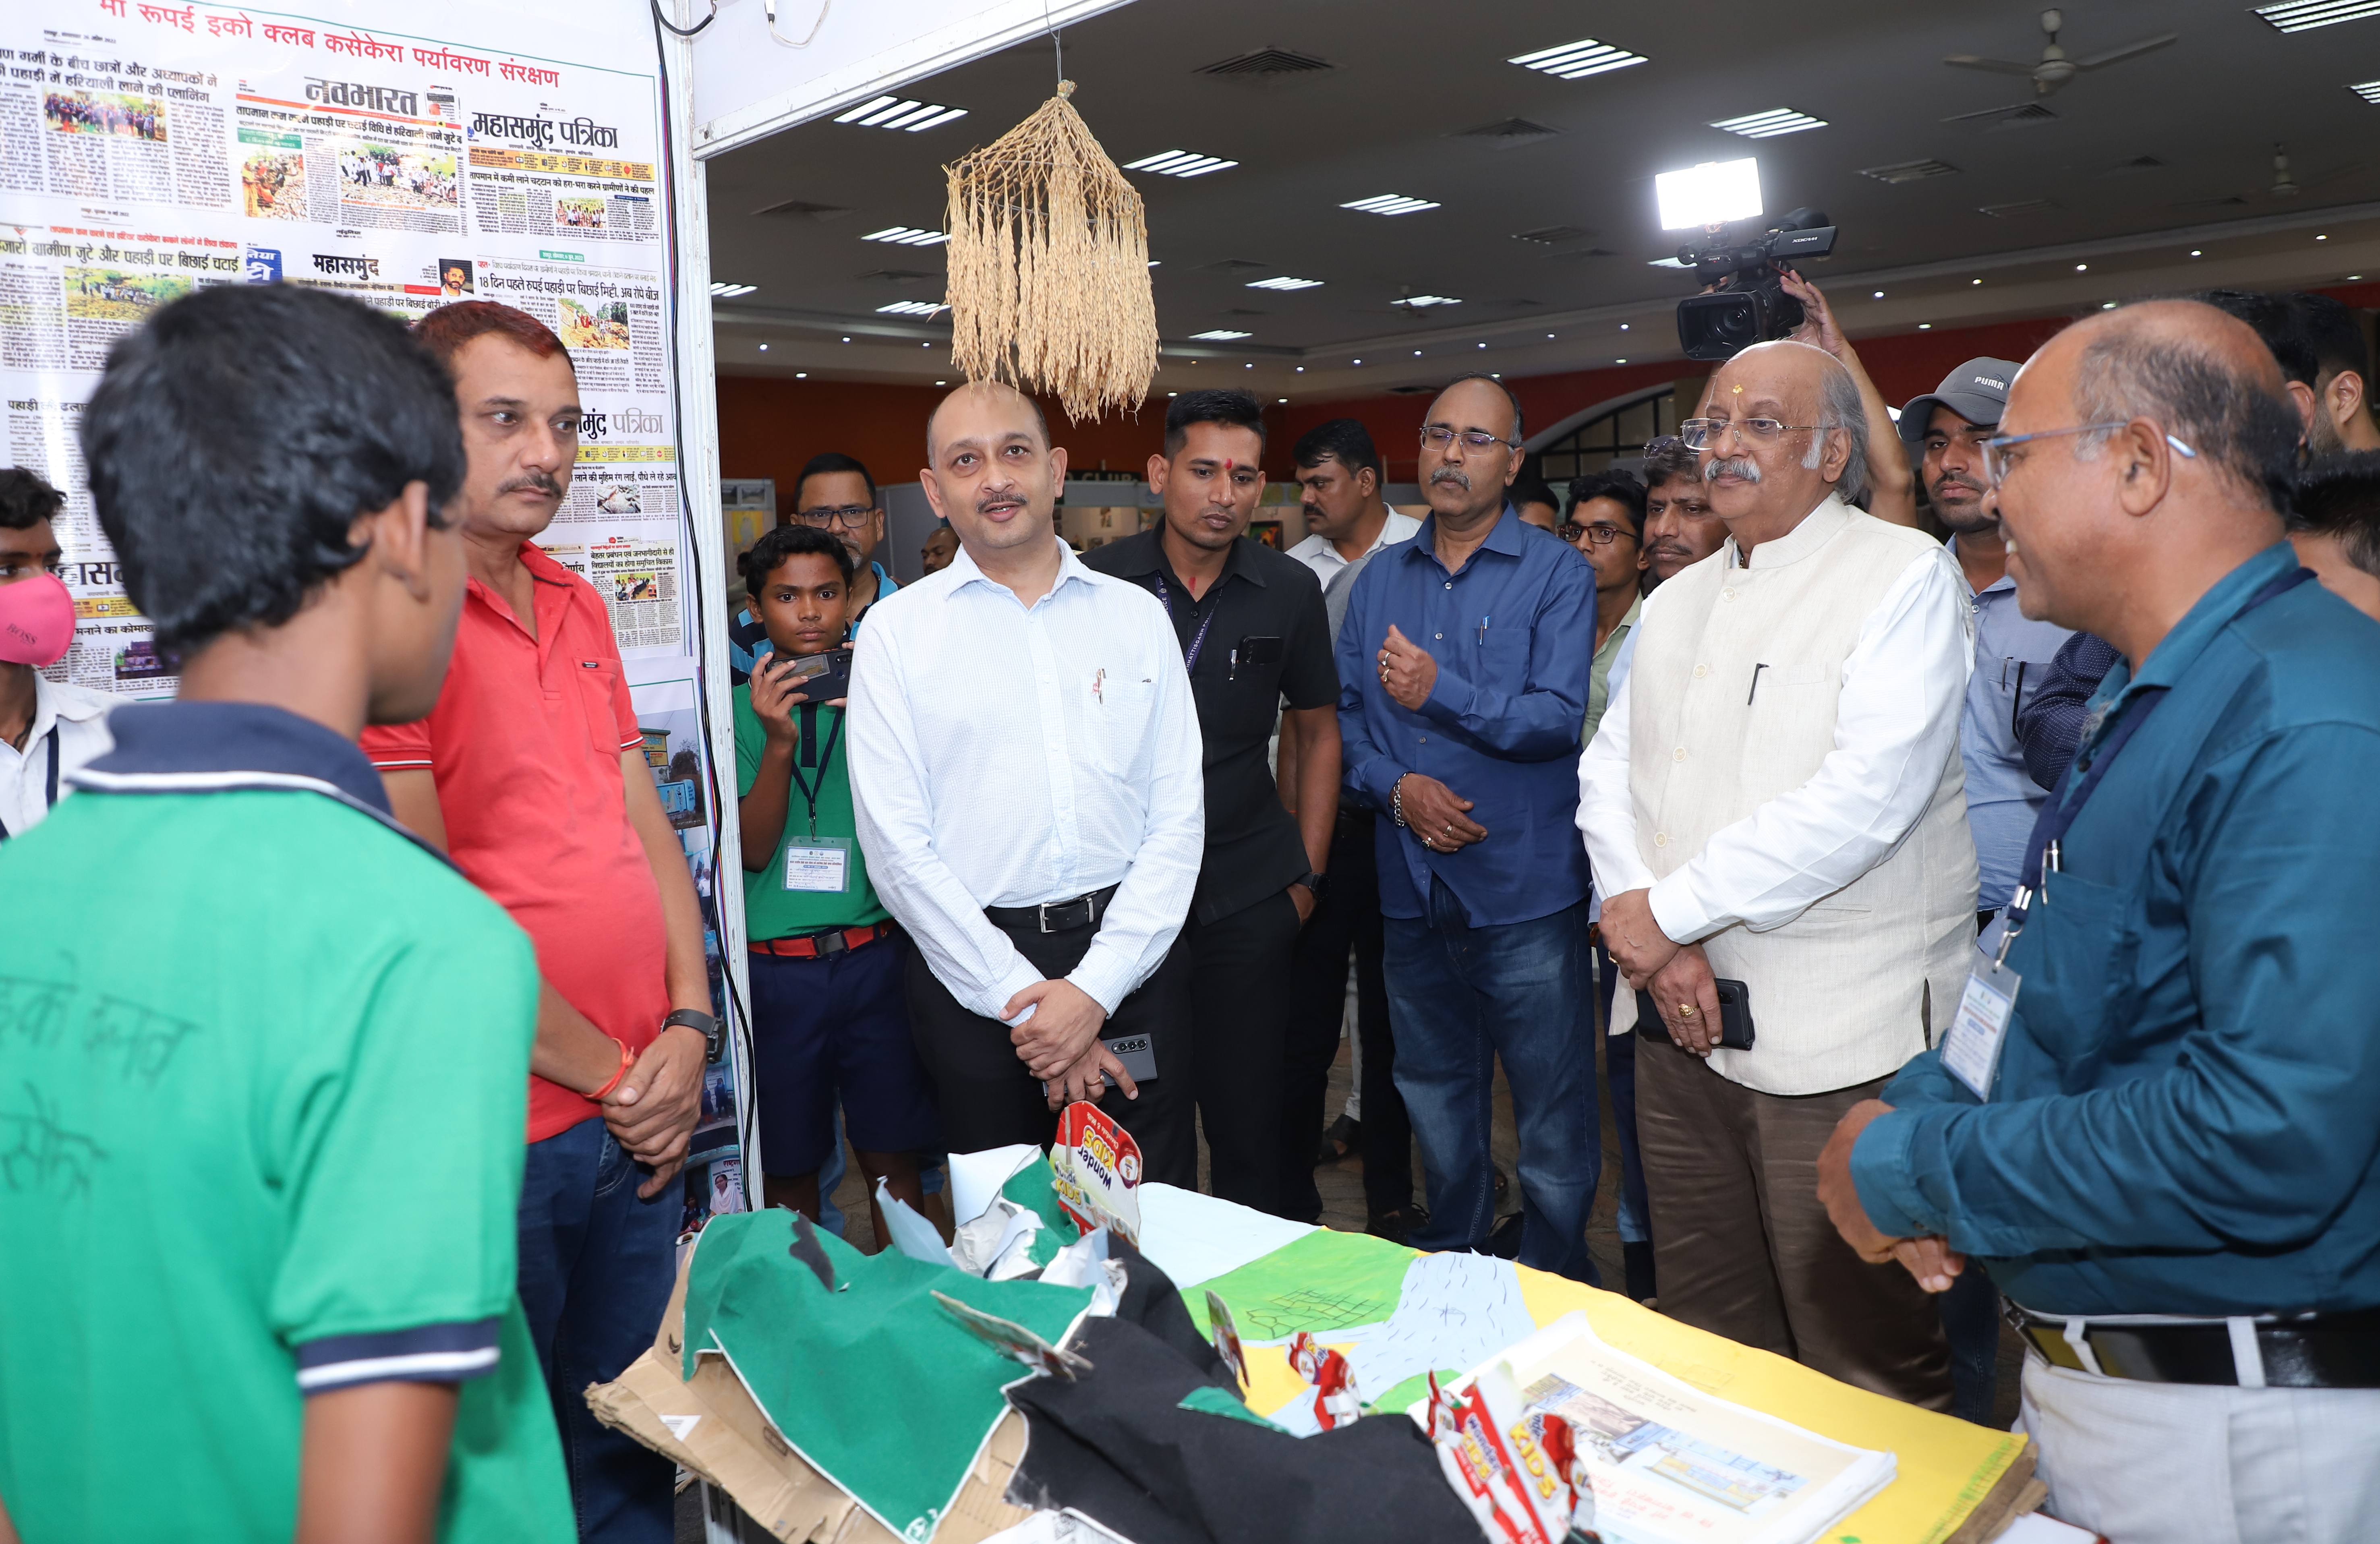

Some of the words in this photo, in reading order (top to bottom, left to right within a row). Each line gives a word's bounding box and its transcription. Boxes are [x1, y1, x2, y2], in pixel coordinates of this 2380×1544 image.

[137, 5, 195, 34] रूपई
[205, 11, 253, 37] इको
[262, 23, 315, 48] क्लब
[323, 31, 404, 62] कसेकेरा
[412, 47, 491, 77] पर्यावरण
[499, 58, 559, 88] संरक्षण
[19, 50, 46, 64] गर्मी
[50, 52, 63, 66] के
[67, 55, 89, 70] बीच
[126, 61, 147, 77] और
[207, 73, 217, 87] ने
[10, 68, 45, 82] पहाड़ी
[65, 73, 114, 89] हरियाली
[118, 80, 144, 93] लाने
[147, 83, 164, 96] की
[167, 87, 210, 102] प्लानिंग
[304, 76, 419, 117] नवभारत
[236, 106, 269, 118] तापमान
[311, 116, 333, 128] पहाड़ी
[335, 119, 346, 128] पर
[368, 120, 384, 134] विधि
[385, 122, 392, 136] से
[394, 126, 424, 139] हरियाली
[426, 130, 443, 141] लाने
[472, 112, 553, 148] महासमुंद
[559, 117, 618, 148] पत्रिका
[470, 172, 492, 181] तापमान
[501, 173, 514, 183] कमी
[516, 174, 529, 184] लाने
[530, 177, 551, 186] चट्टान
[553, 177, 562, 186] को
[563, 180, 586, 189] हरा-भरा
[587, 181, 601, 190] करने
[602, 181, 623, 192] ग्रामीणों
[625, 183, 629, 192] ने
[630, 184, 639, 194] की
[31, 240, 72, 258] ग्रामीण
[75, 242, 93, 264] जुटे
[99, 243, 120, 262] और
[124, 248, 155, 267] पहाड़ी
[158, 252, 174, 266] पर
[178, 251, 210, 271] बिछाई
[213, 255, 240, 273] चटाई
[312, 253, 379, 281] महासमुंद
[479, 277, 489, 288] 18
[490, 273, 504, 289] दिन
[506, 276, 525, 291] पहले
[526, 277, 543, 293] रुपई
[544, 279, 565, 296] पहाड़ी
[567, 283, 576, 294] पर
[578, 280, 599, 298] बिछाई
[621, 288, 632, 299] अब
[633, 286, 644, 300] रोपे
[645, 286, 659, 301] बीज
[375, 296, 394, 307] पहाड़ी
[406, 298, 425, 309] बिछाई
[427, 299, 441, 309] बोरी
[1974, 376, 2004, 391] PUMA
[612, 408, 663, 433] पत्रिका
[575, 472, 587, 482] लाने
[588, 472, 597, 482] की
[599, 472, 613, 484] मुहिम
[624, 472, 637, 483] लाई,
[638, 470, 648, 482] पौधे
[650, 471, 656, 482] ले
[590, 551, 605, 559] बेहतर
[606, 551, 623, 559] प्रबंधन
[633, 548, 662, 558] जनभागीदारी
[663, 548, 667, 556] से
[669, 547, 674, 556] ही
[591, 560, 614, 569] विद्यालयों
[636, 559, 655, 567] समुचित
[75, 624, 101, 635] मनाने
[1186, 628, 1204, 672] CHHATTISGARH
[1083, 1126, 1115, 1172] KIDS
[1078, 1146, 1112, 1190] Wonder
[1056, 1178, 1081, 1205] KIDS
[1509, 1420, 1557, 1499] KIDS
